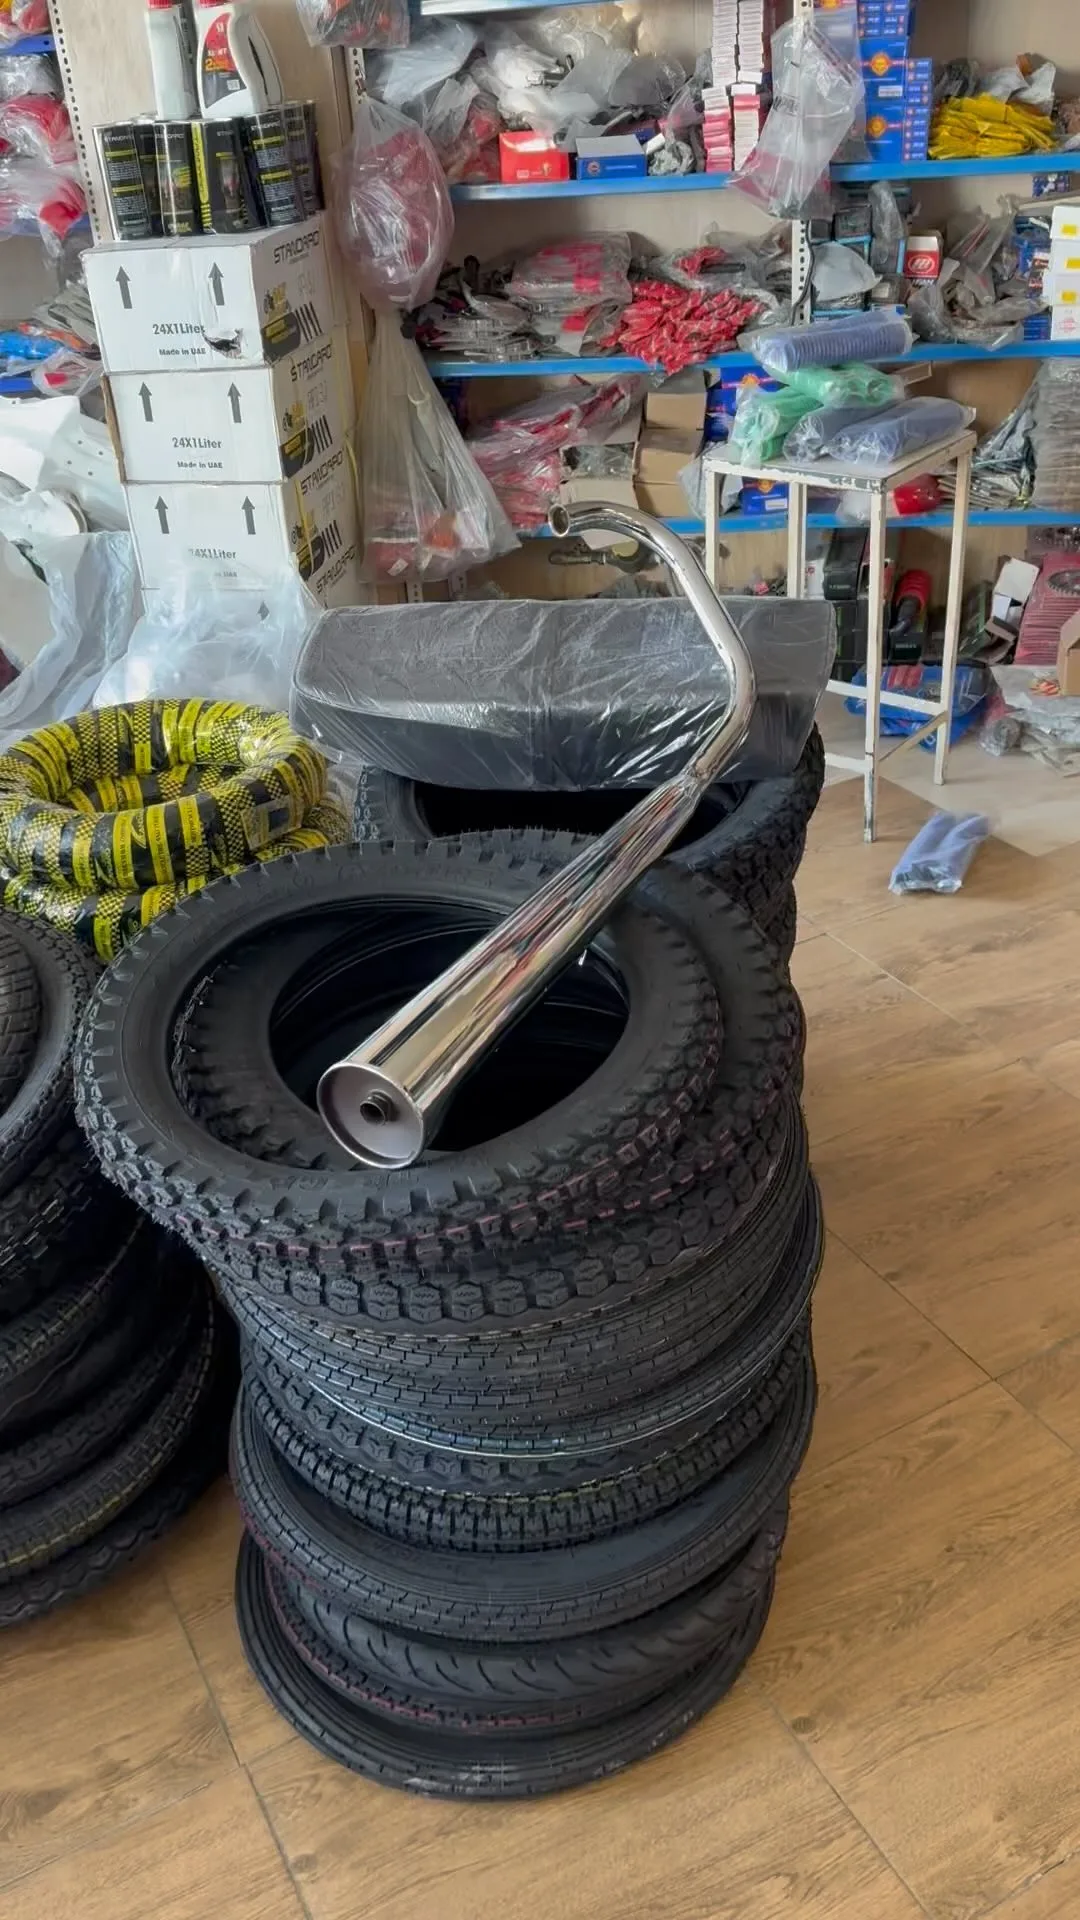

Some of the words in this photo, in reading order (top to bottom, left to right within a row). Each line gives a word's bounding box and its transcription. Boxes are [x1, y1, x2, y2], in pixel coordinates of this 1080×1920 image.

[273, 230, 320, 264] STANDARD
[159, 348, 180, 356] Made
[190, 347, 207, 356] UAE
[289, 343, 332, 382] STANDARD
[176, 460, 197, 468] Made
[207, 461, 223, 469] UAE
[300, 450, 344, 496] STANDARD
